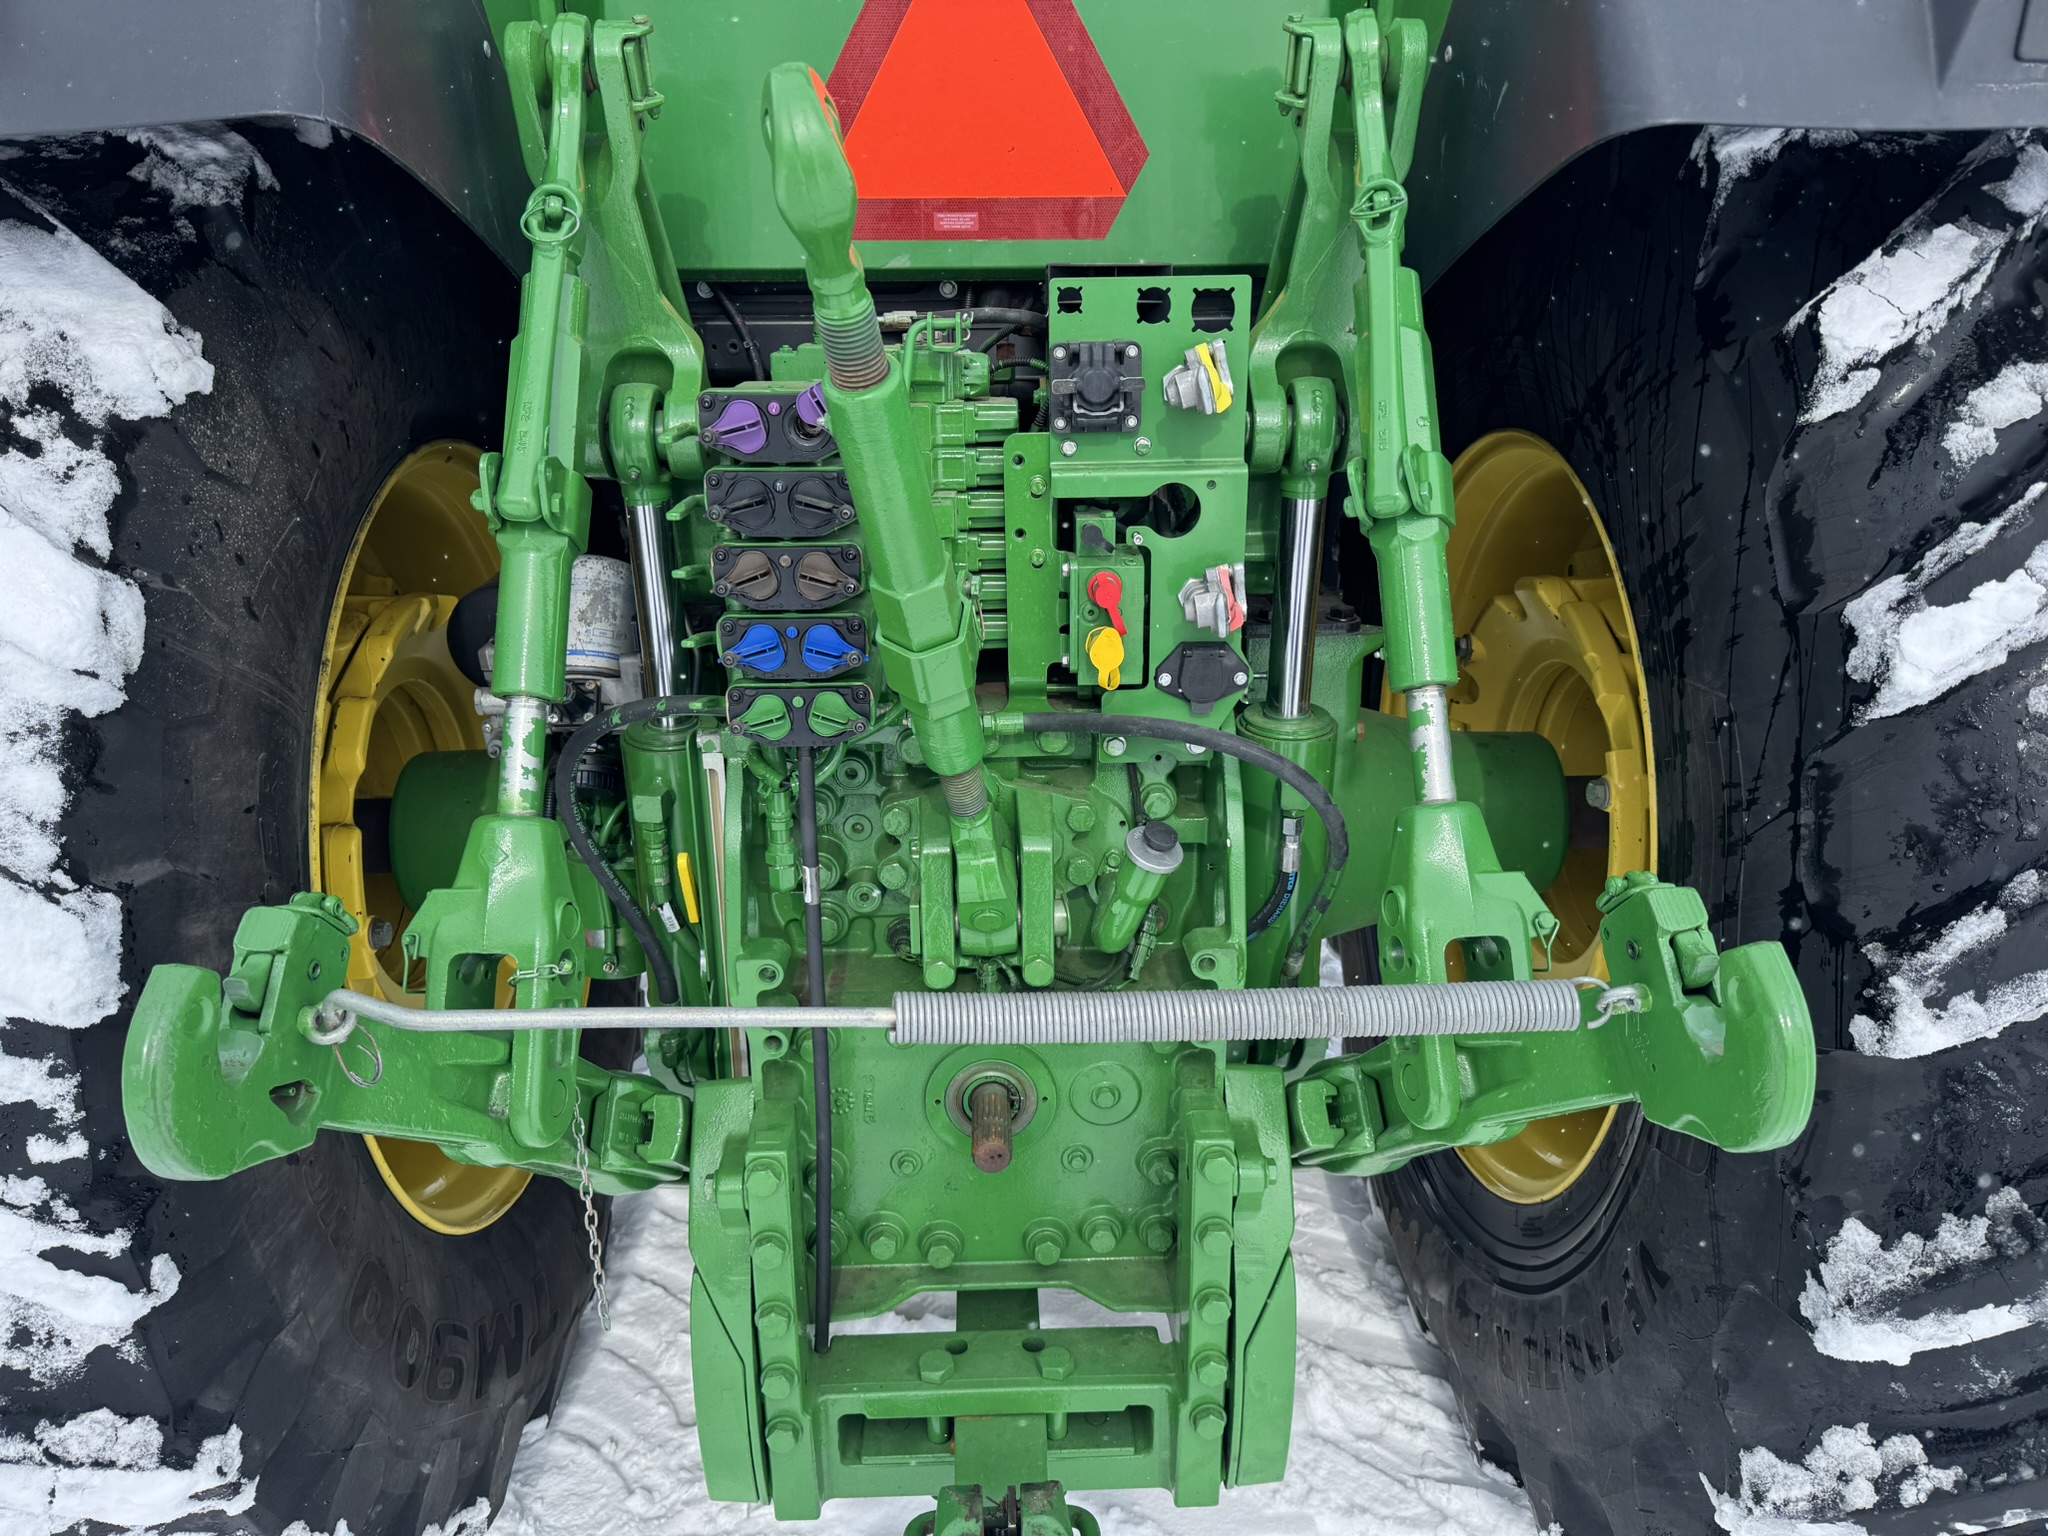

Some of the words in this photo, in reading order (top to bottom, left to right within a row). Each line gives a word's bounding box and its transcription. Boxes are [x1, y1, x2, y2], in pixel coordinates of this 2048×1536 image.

[600, 860, 615, 880] Made
[613, 878, 620, 887] in
[618, 885, 631, 902] USA
[1267, 893, 1291, 924] DIEHARD
[345, 1253, 560, 1404] TM900
